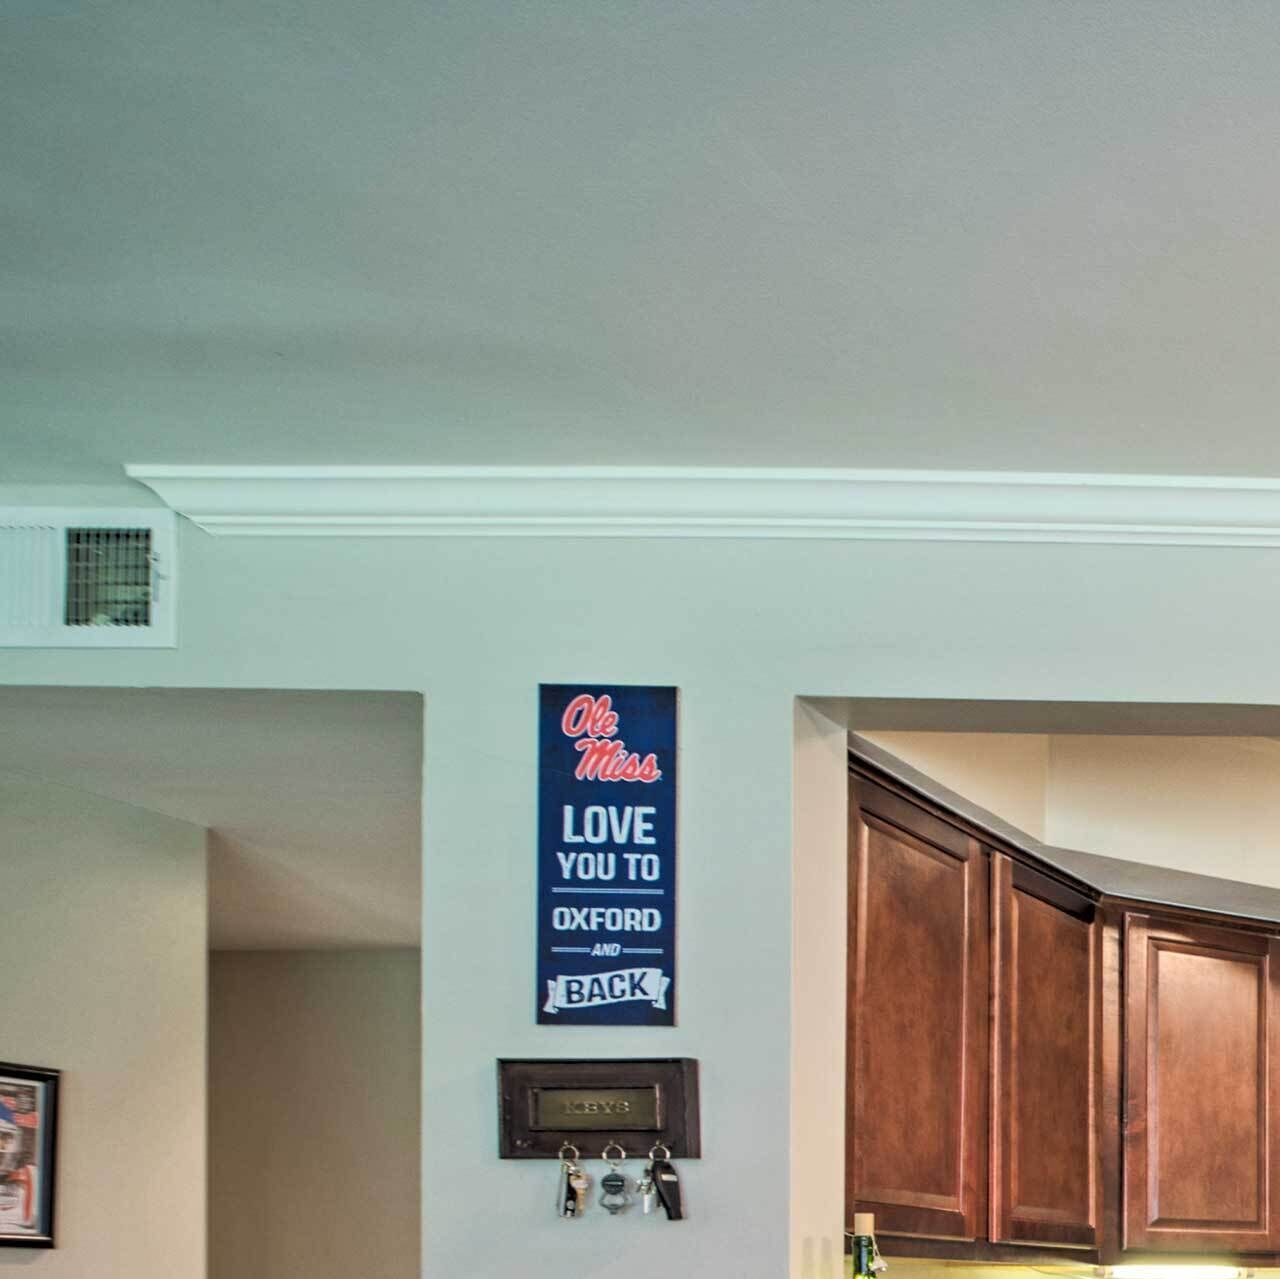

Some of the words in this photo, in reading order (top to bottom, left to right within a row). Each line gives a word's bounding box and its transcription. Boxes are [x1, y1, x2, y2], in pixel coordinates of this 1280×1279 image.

[562, 694, 619, 737] Ole
[574, 739, 662, 782] Miss
[562, 804, 656, 844] LOVE
[556, 852, 616, 880] YOU
[623, 853, 660, 881] TO
[552, 906, 661, 932] OXFORD
[591, 943, 621, 957] AND
[565, 971, 649, 1004] BACK
[563, 1101, 630, 1114] KEYS
